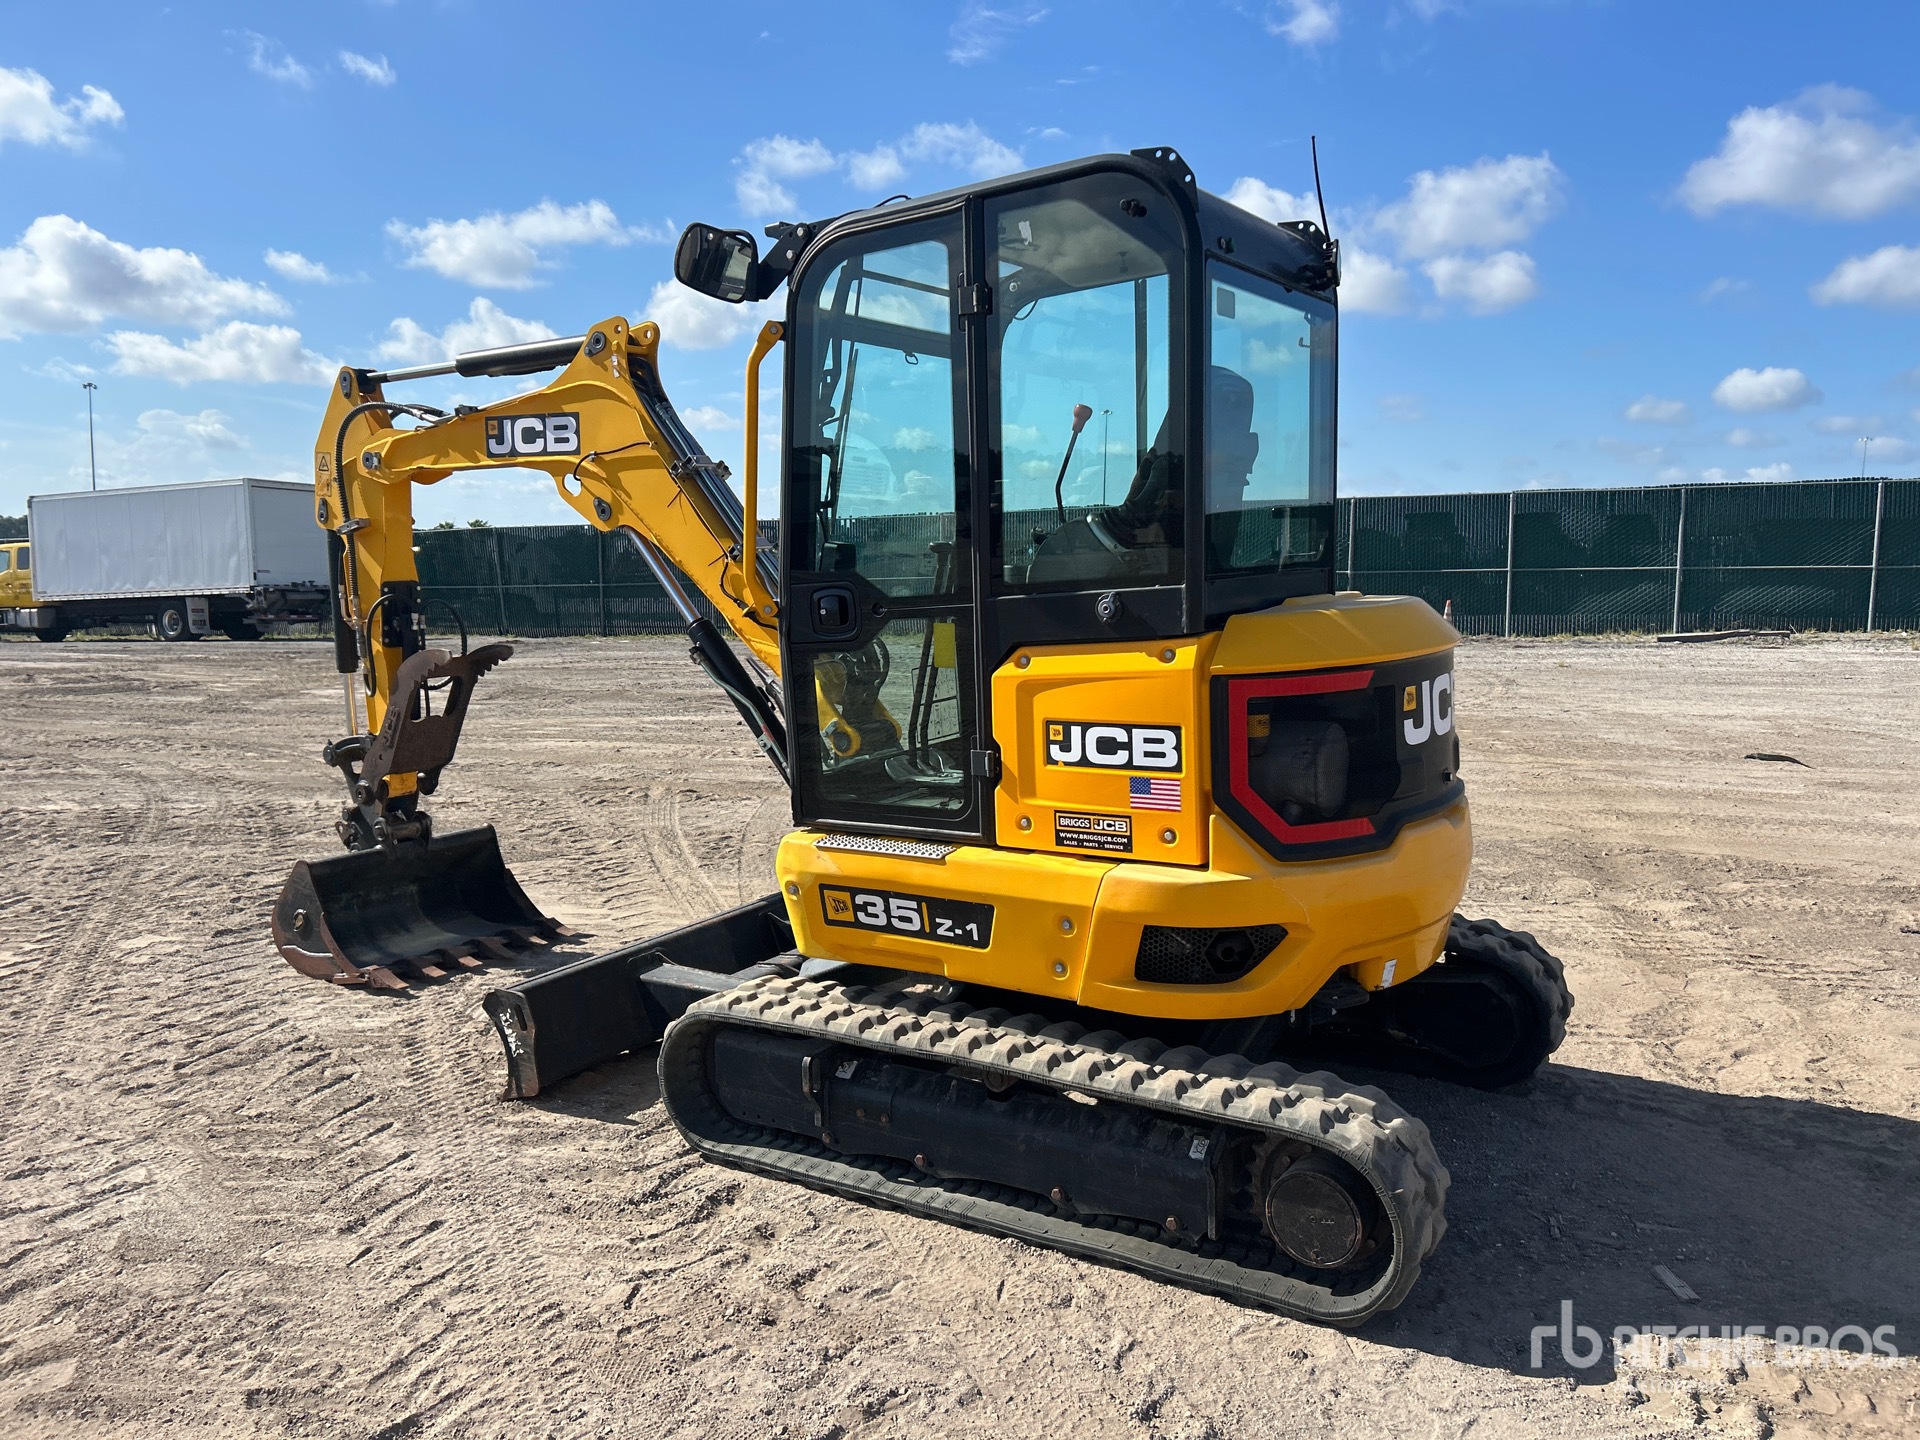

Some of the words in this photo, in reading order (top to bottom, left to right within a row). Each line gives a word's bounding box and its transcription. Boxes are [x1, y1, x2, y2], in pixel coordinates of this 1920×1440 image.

[488, 416, 578, 454] JCB
[1403, 669, 1456, 745] JC
[1050, 725, 1179, 768] JCB
[1059, 832, 1128, 844] WWW.BRIGGSJCB.COM
[1060, 817, 1090, 828] BRIGGS
[1094, 820, 1127, 832] JCB
[855, 894, 921, 931] 35
[935, 917, 979, 941] Z-1
